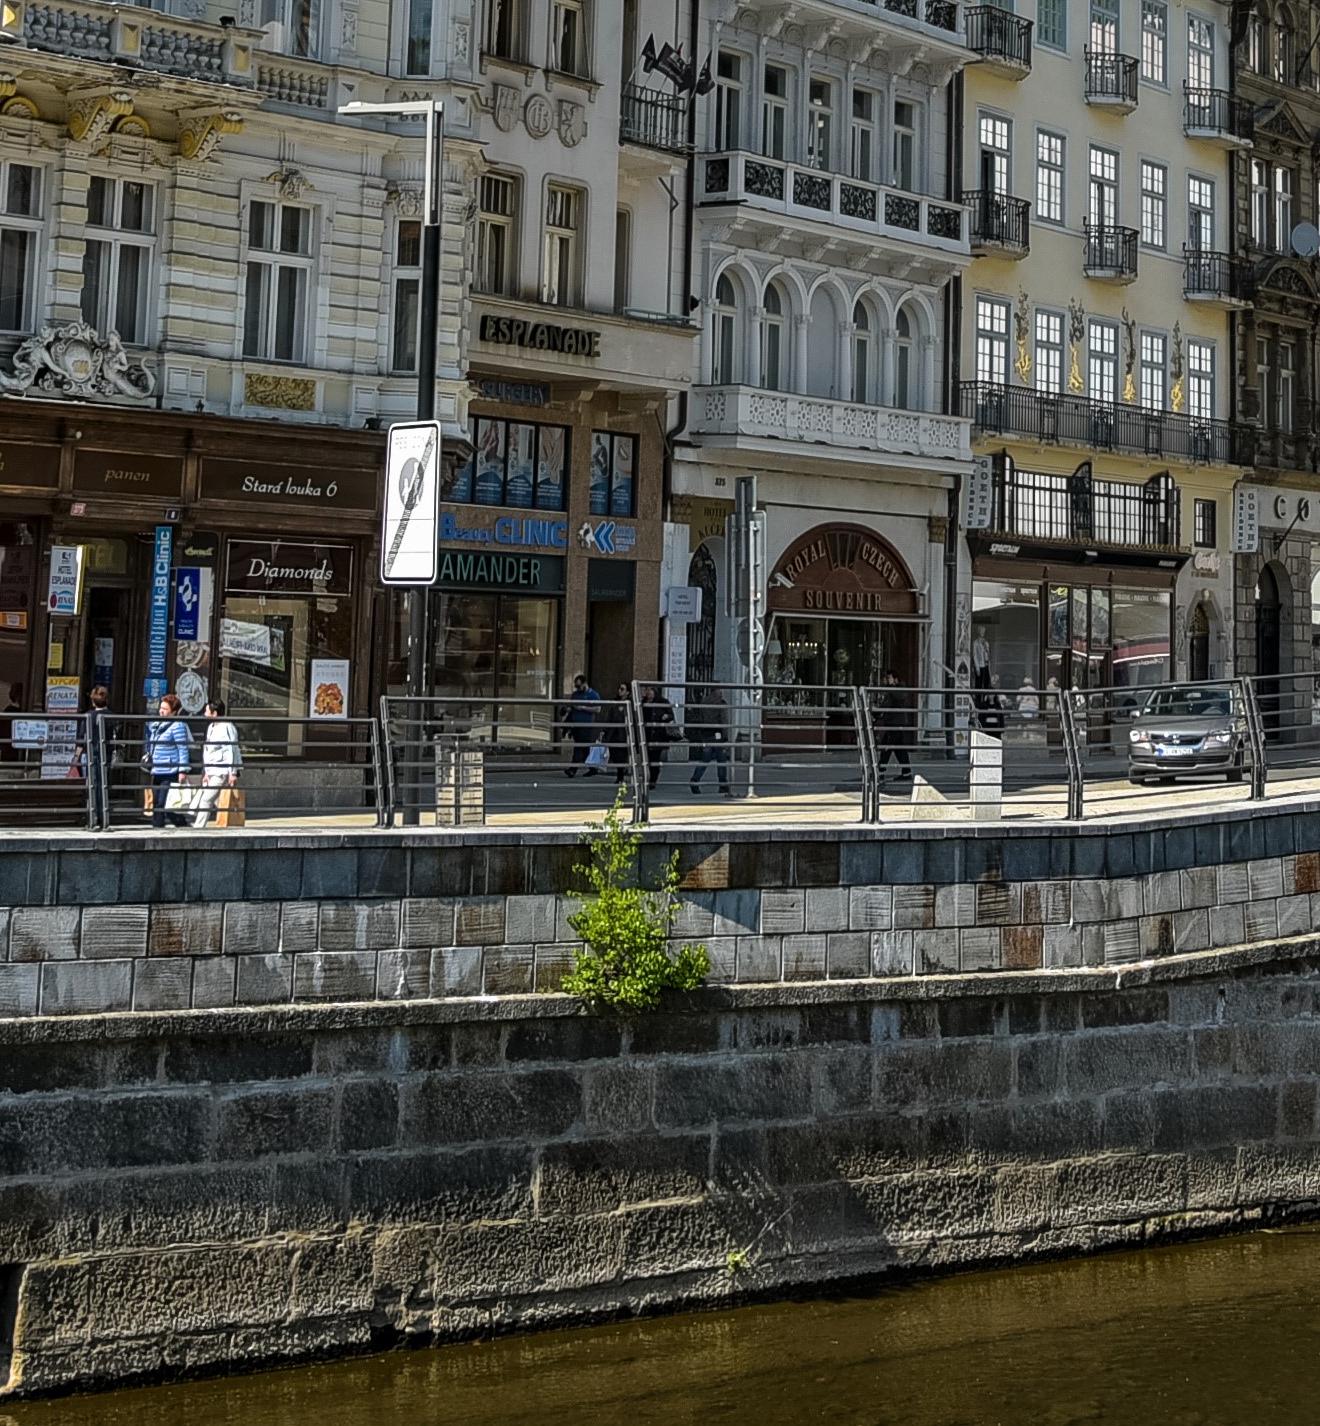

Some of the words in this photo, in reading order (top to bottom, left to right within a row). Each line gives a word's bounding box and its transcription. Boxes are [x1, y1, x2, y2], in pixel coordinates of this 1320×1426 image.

[483, 315, 602, 358] ESPLANADE
[104, 469, 151, 483] panen
[241, 476, 282, 495] Stará
[285, 477, 322, 497] louka
[325, 480, 338, 498] 6
[977, 459, 989, 527] GOETHE
[967, 468, 977, 527] SIDENCE
[495, 517, 568, 548] CLINIC
[1246, 492, 1256, 551] GOETHE
[156, 530, 171, 575] Clinic
[246, 559, 334, 580] Diamonds
[439, 553, 541, 586] AMANDER
[785, 540, 827, 581] ROYAL
[862, 542, 899, 588] CZECH
[154, 576, 168, 607] H&B
[806, 589, 883, 611] SOUVENIR
